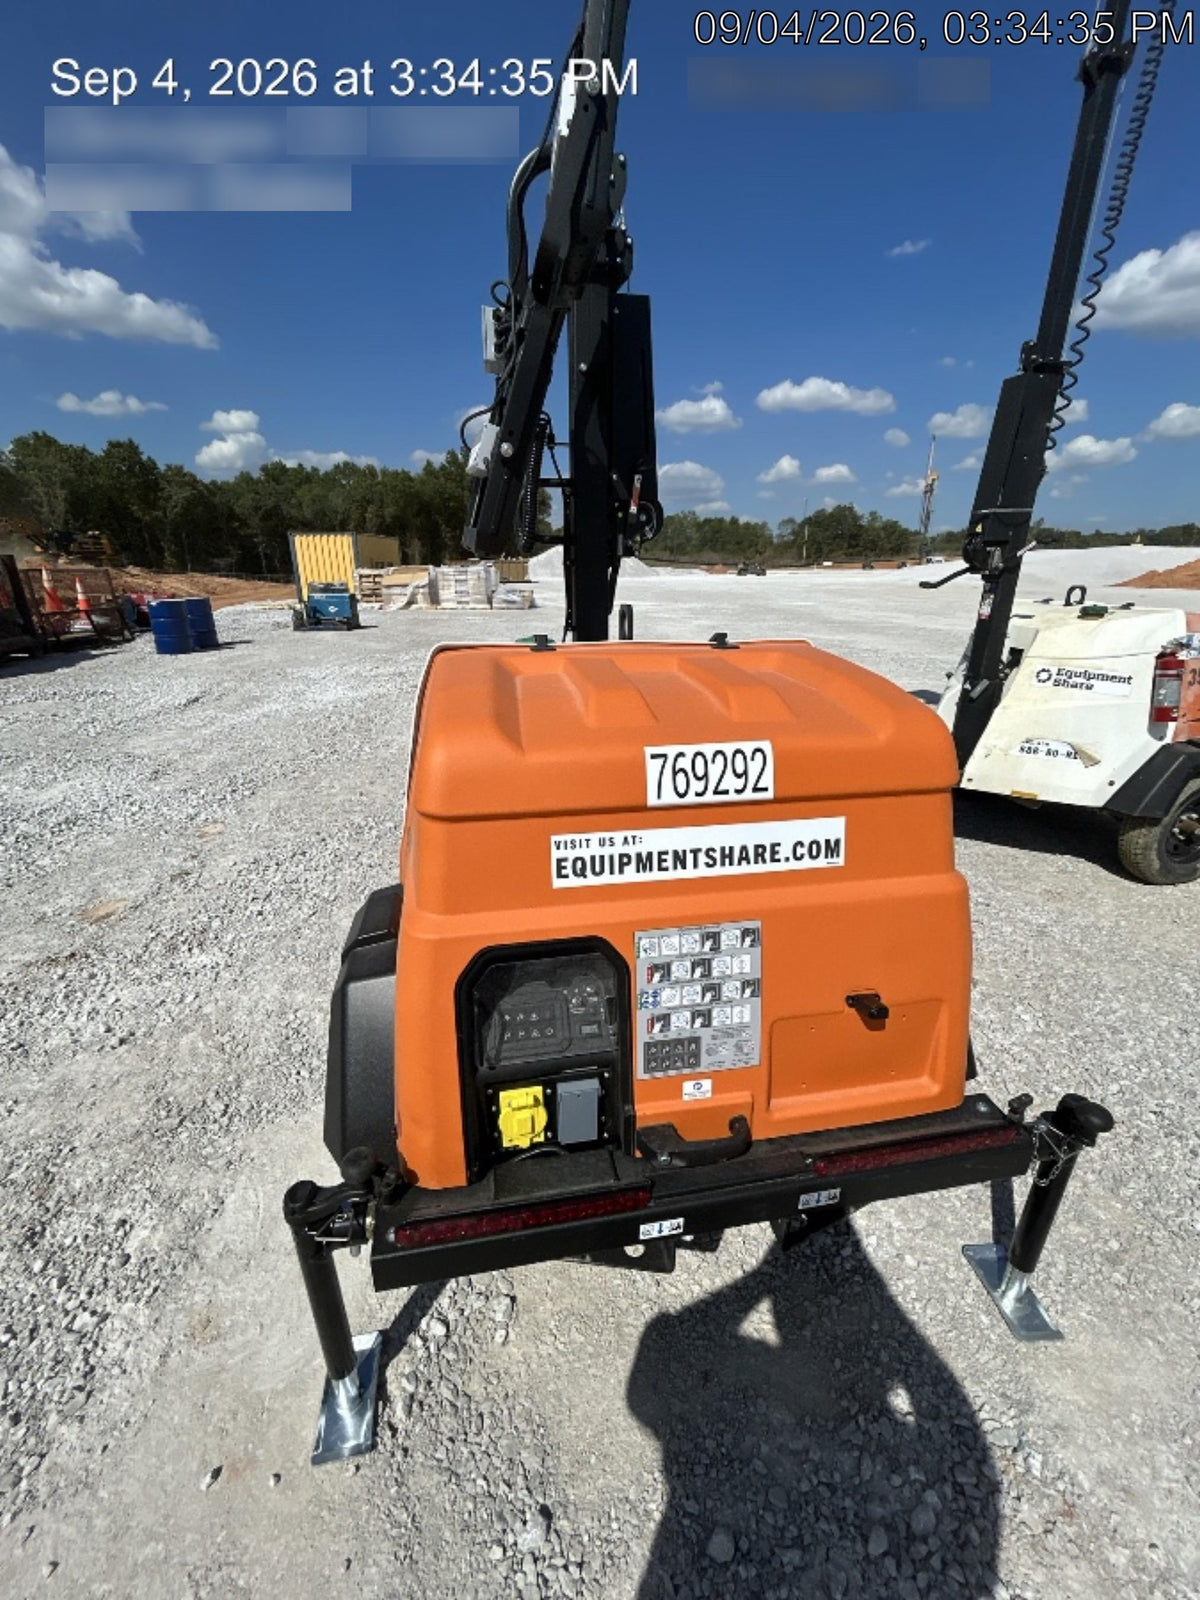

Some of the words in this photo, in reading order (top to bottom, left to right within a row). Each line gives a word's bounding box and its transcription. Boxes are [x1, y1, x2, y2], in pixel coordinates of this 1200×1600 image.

[1052, 678, 1094, 690] Share
[1055, 668, 1133, 685] Equipment
[650, 747, 769, 800] 769292
[554, 838, 591, 850] VISIT
[598, 836, 616, 848] US
[622, 835, 643, 847] AT:
[556, 838, 841, 879] EQUIPMENTSHARE.COM
